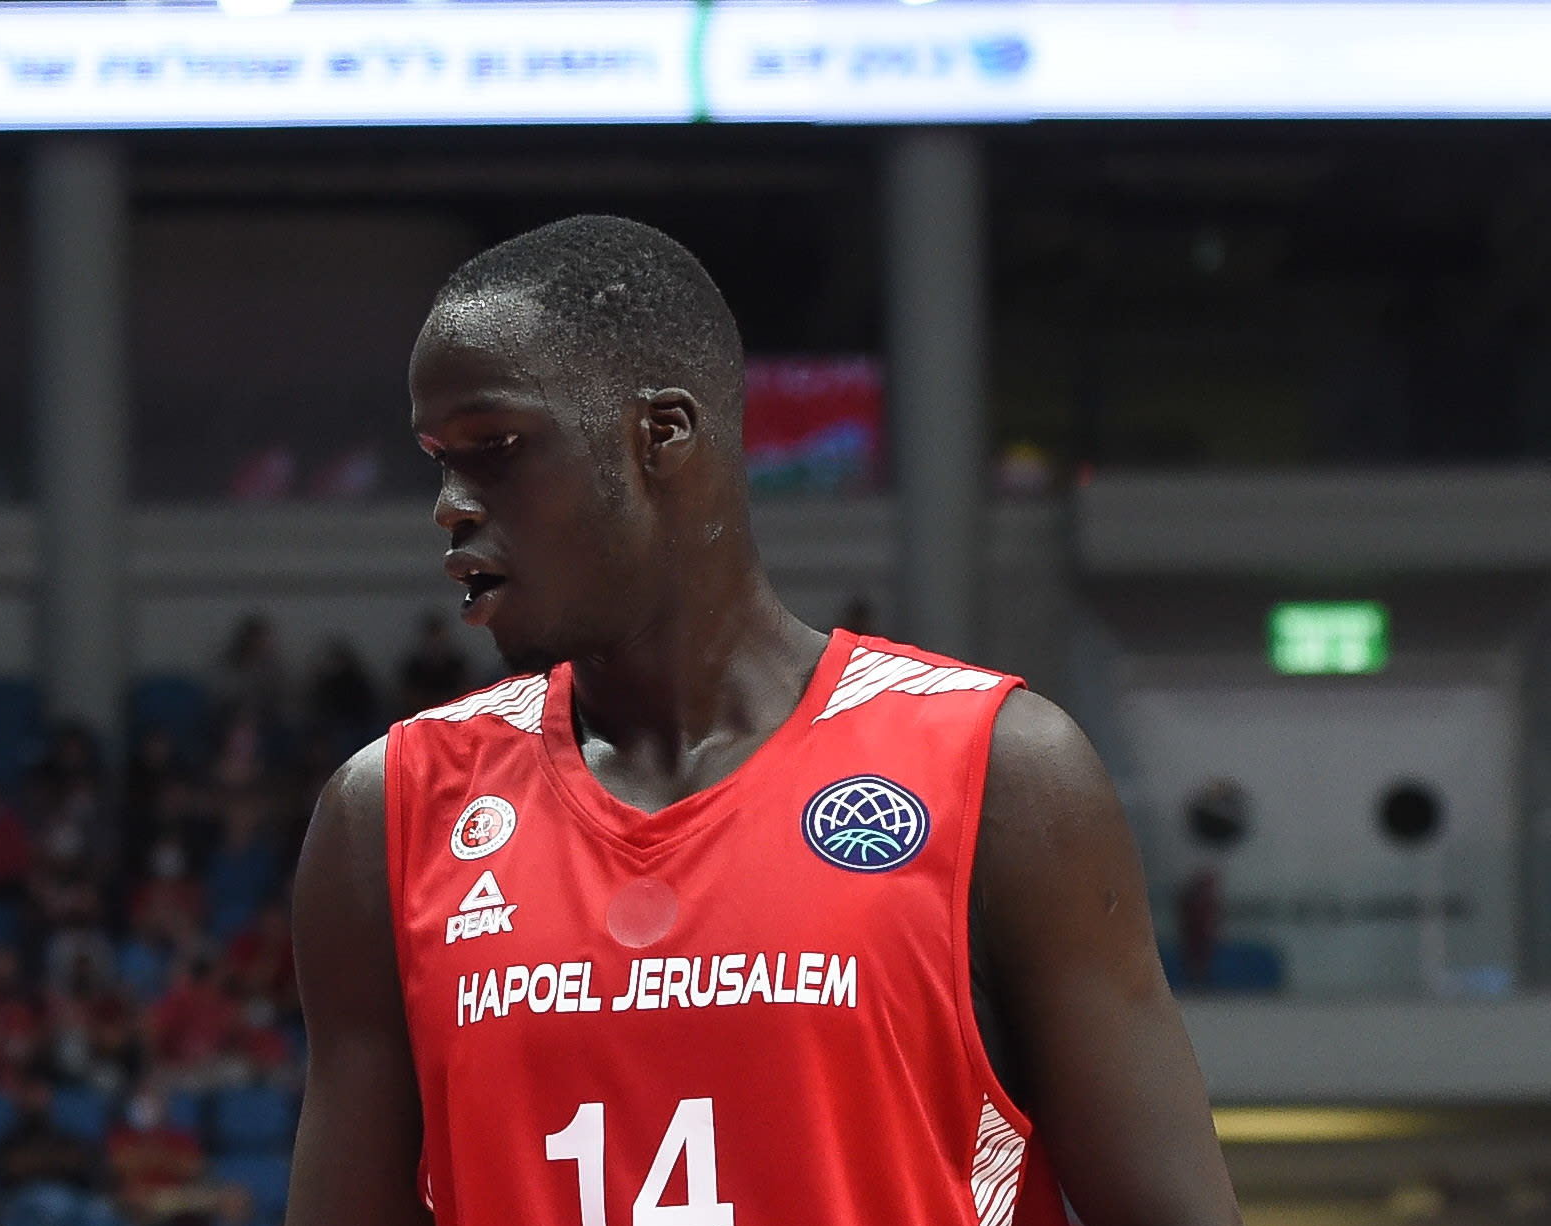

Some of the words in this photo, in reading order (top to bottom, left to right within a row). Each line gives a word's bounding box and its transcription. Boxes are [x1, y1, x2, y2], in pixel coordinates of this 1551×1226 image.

[445, 904, 518, 945] PEAK
[457, 962, 601, 1027] HAPOEL
[612, 952, 858, 1013] JERUSALEM
